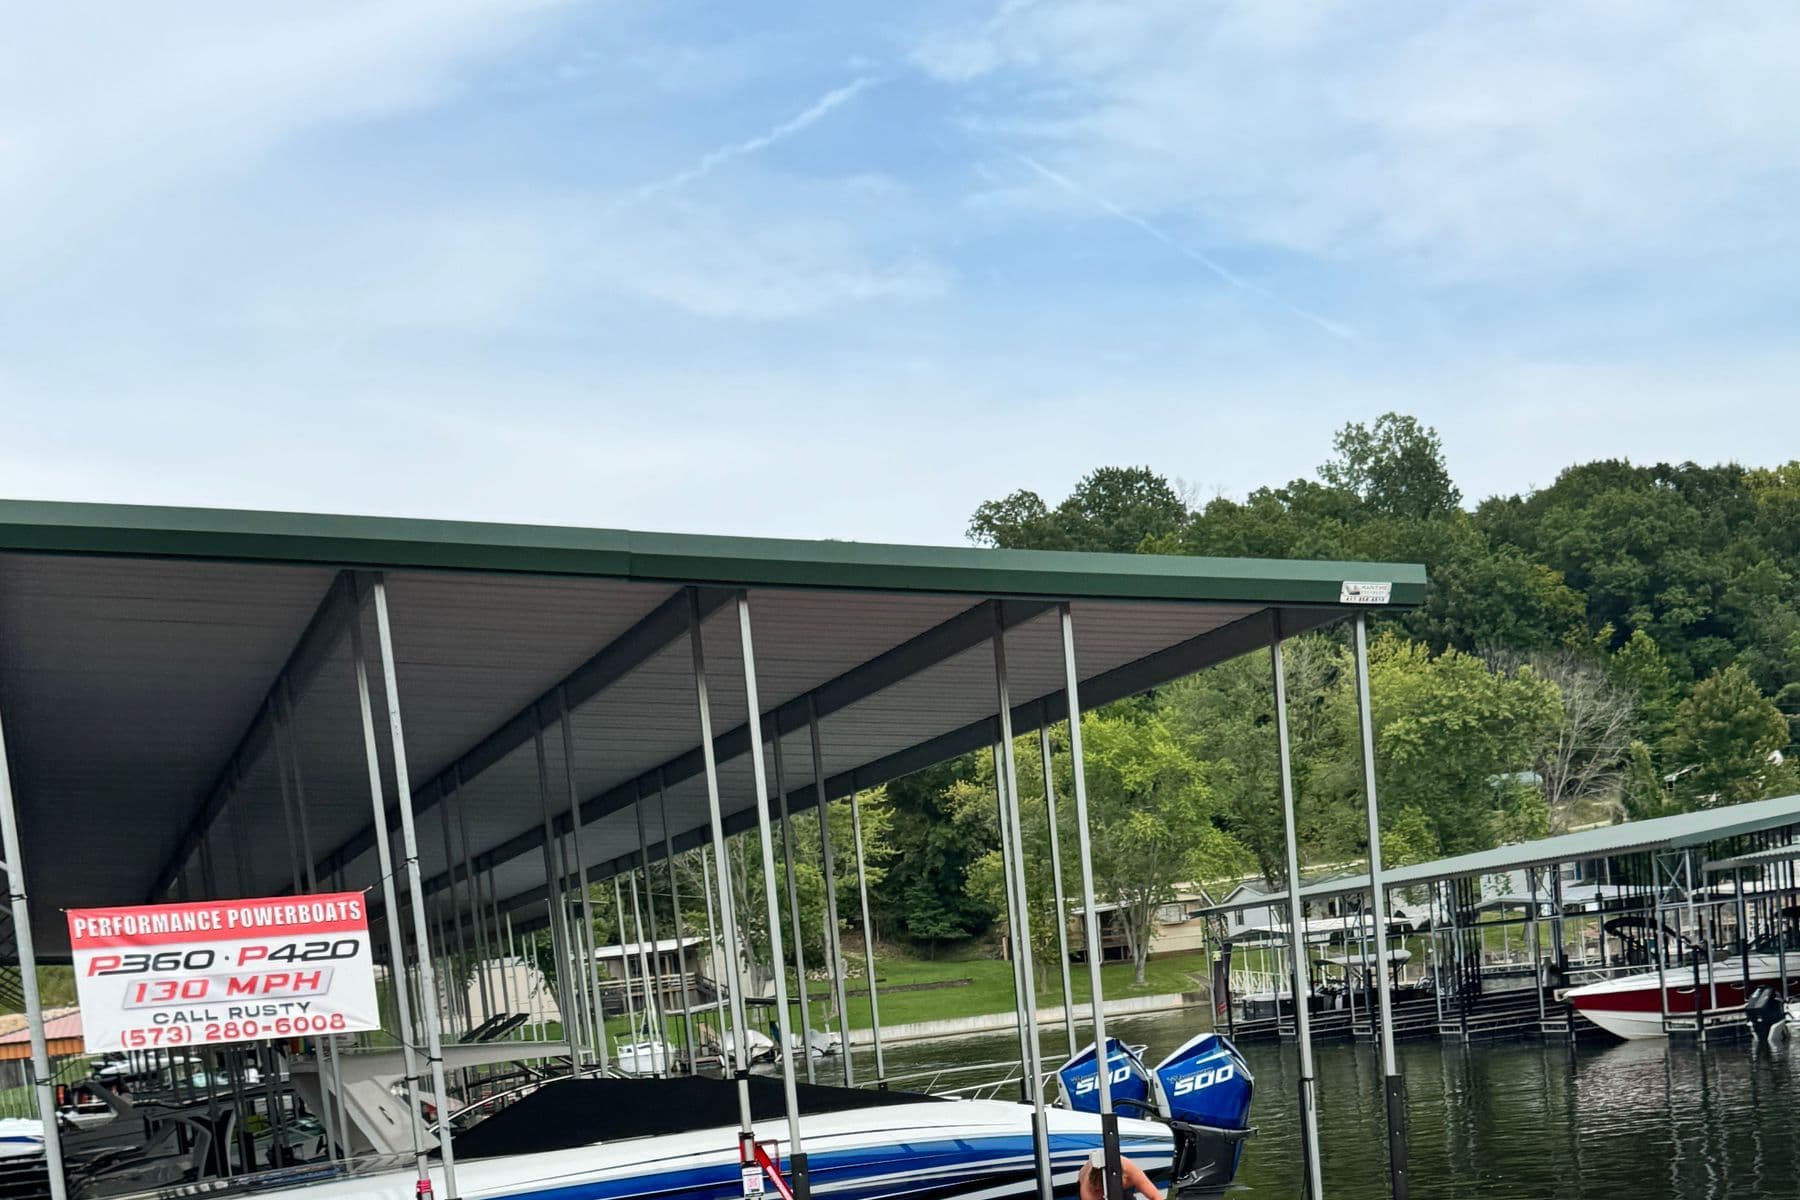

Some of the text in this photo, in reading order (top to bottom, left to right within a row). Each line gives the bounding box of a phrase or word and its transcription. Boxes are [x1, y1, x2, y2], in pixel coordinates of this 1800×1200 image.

[74, 900, 361, 939] PERFORMANCE POWERBOATS
[87, 939, 360, 977] P360 P420
[135, 971, 322, 1003] 130 MPH
[153, 1001, 311, 1024] CALL RUSTY
[120, 1013, 346, 1048] (573) 280-6008
[1173, 1063, 1234, 1097] 500
